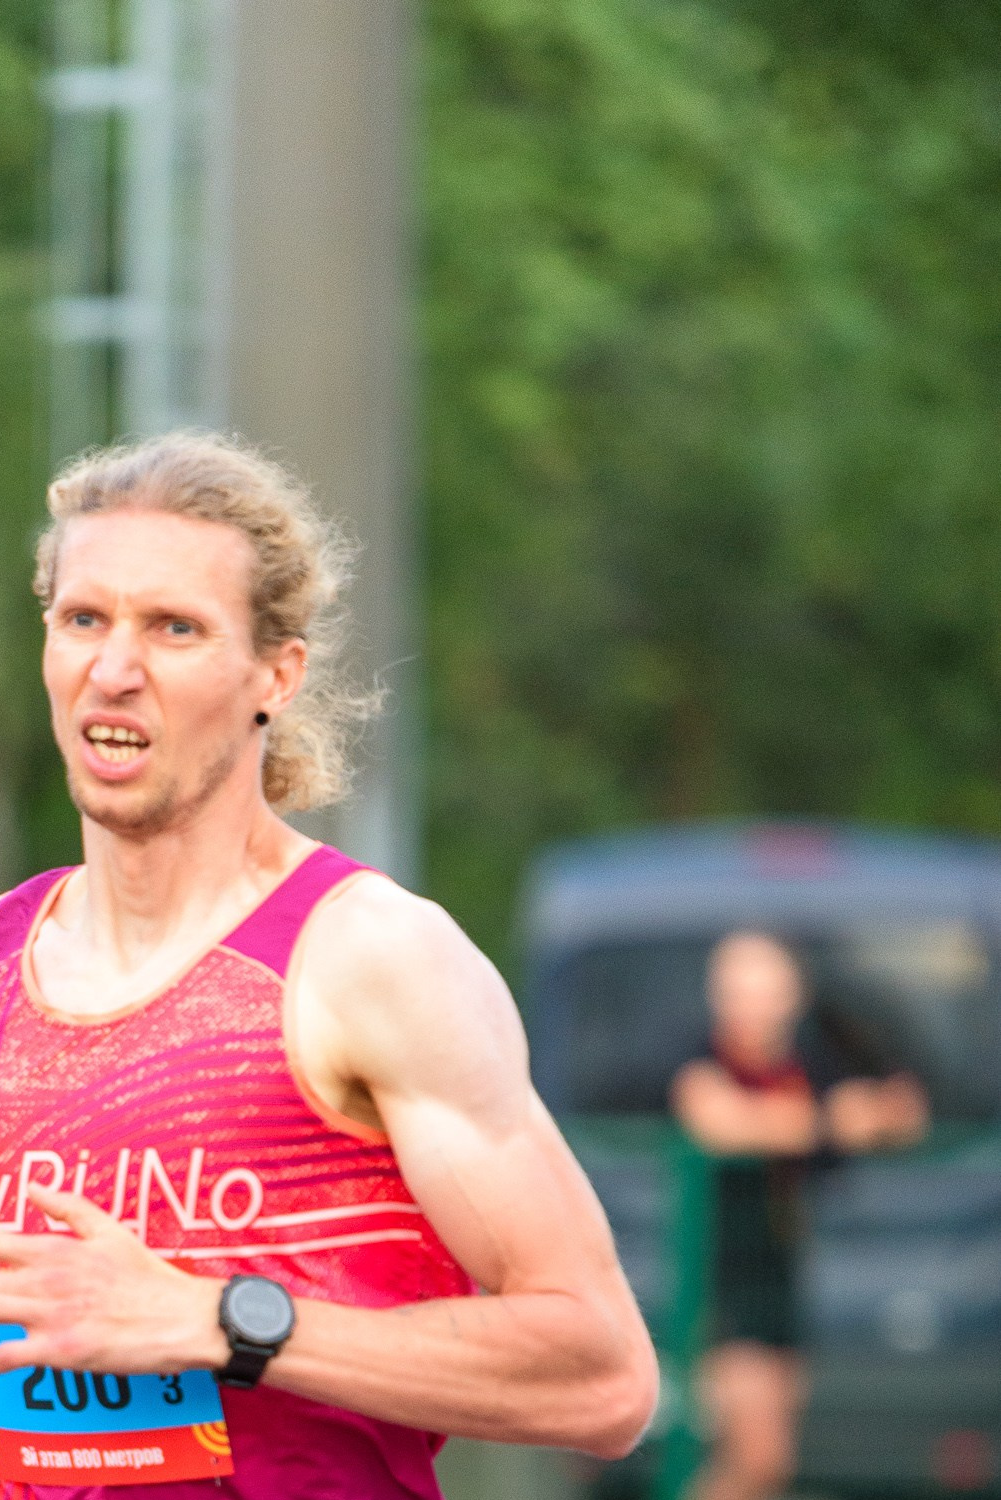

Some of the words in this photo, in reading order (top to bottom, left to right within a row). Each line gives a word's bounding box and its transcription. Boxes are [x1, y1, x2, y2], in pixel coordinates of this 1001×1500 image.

[39, 1450, 72, 1468] этап
[72, 1448, 102, 1468] 800
[103, 1446, 165, 1469] метров
